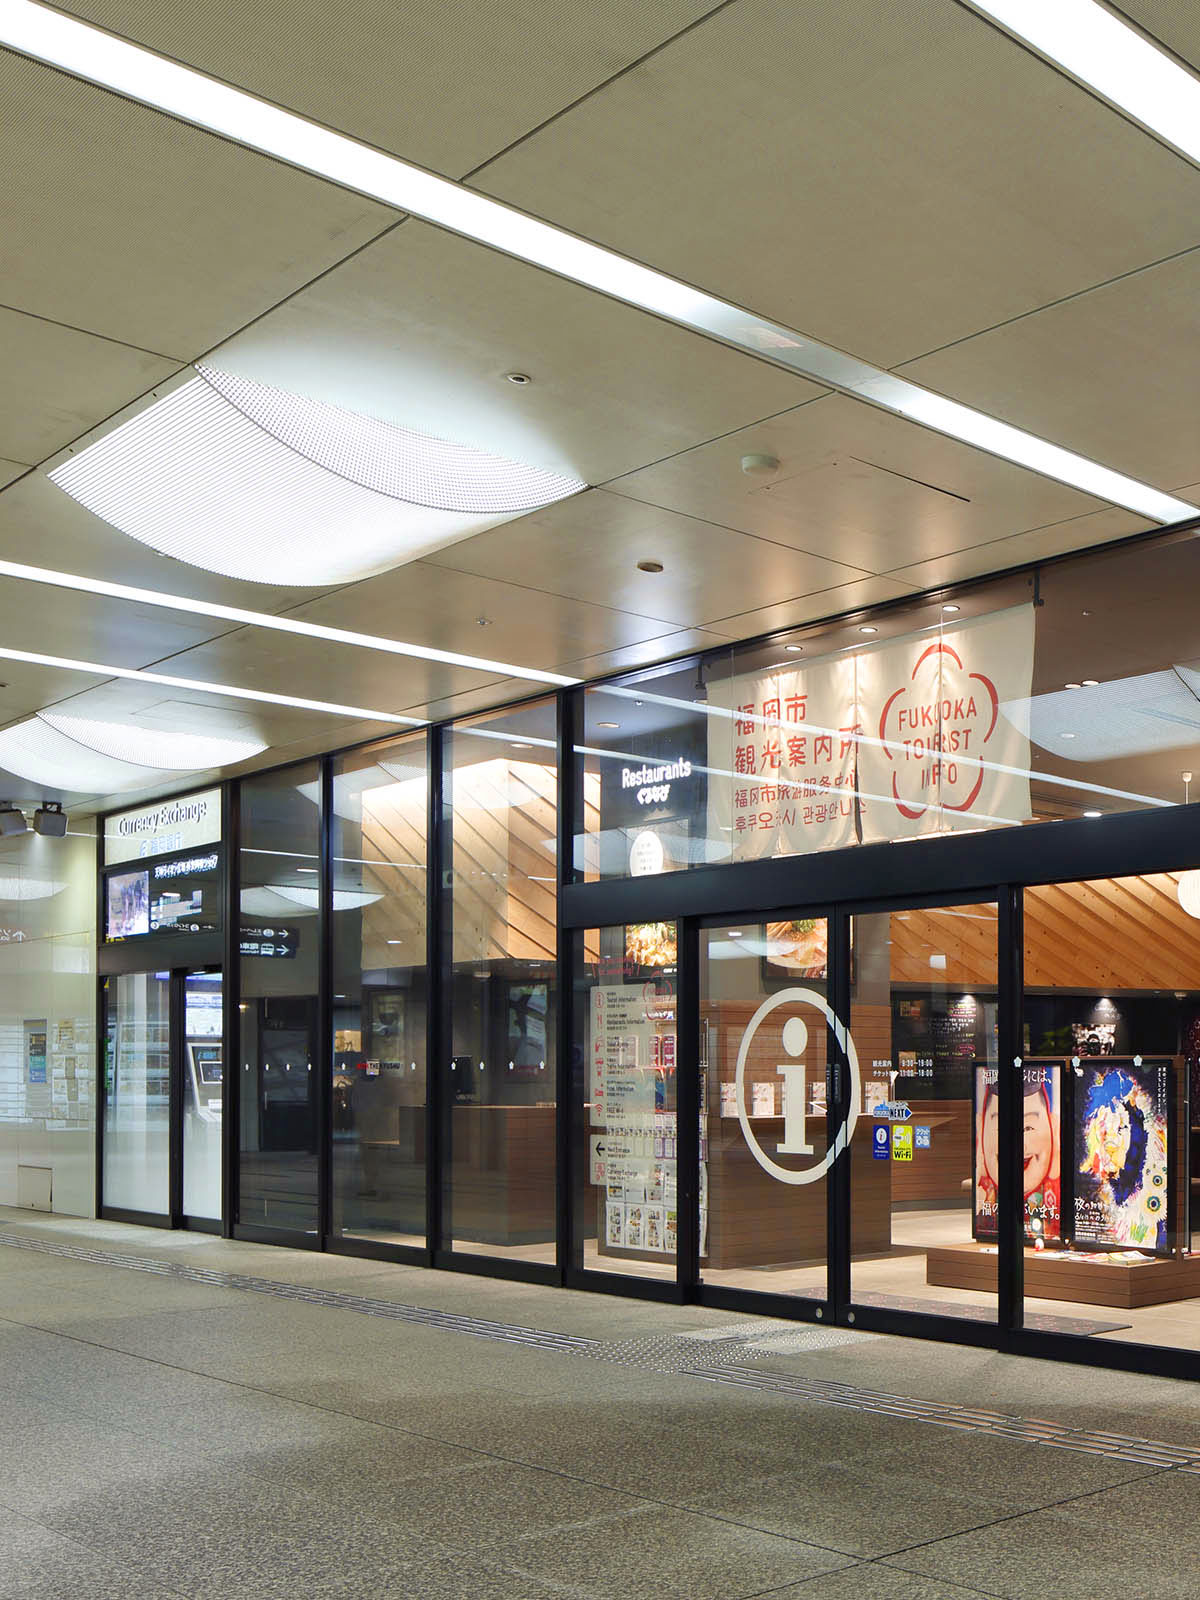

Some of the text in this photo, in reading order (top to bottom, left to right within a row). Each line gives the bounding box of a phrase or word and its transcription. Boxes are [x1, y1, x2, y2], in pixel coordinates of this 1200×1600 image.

[735, 693, 808, 737] 福岡市
[735, 723, 864, 776] 観光案内所
[622, 756, 692, 788] Restaurants
[118, 801, 207, 836] Currency Exchange
[889, 1108, 905, 1118] NEXT
